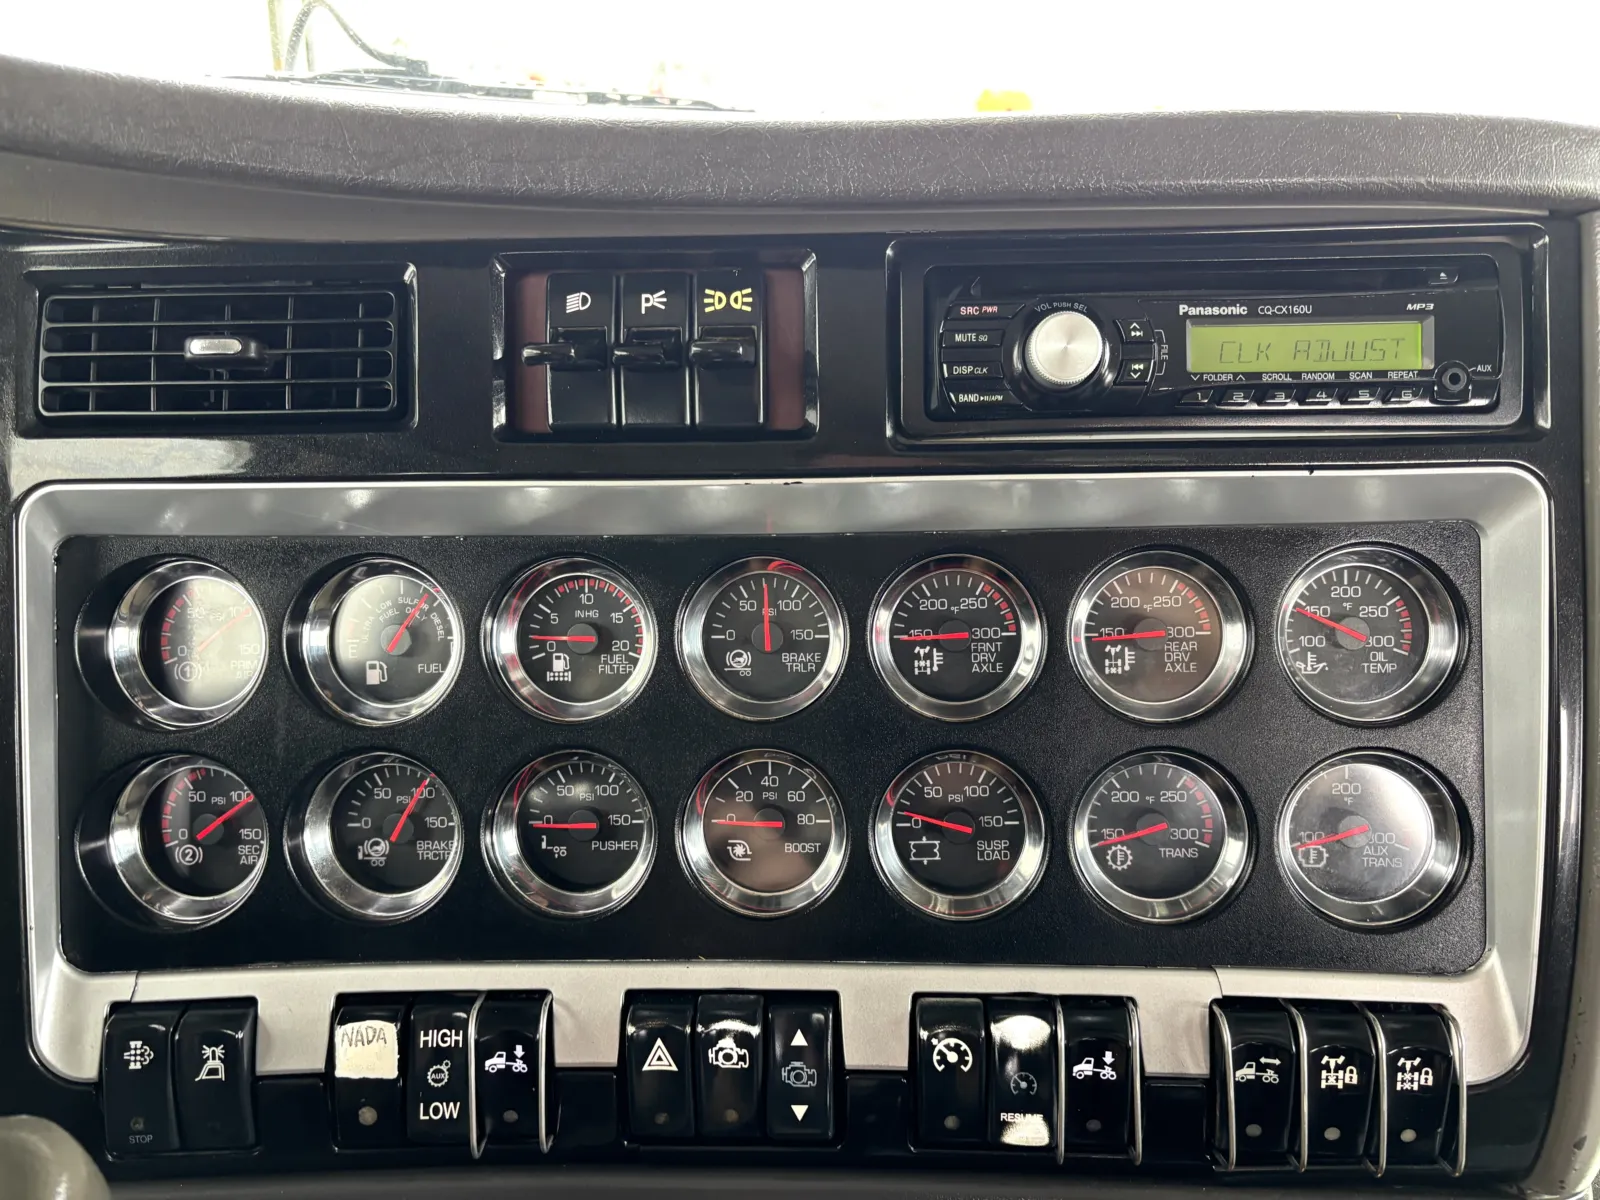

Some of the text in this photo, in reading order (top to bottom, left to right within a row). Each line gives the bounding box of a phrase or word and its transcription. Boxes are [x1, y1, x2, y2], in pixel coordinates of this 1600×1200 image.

[960, 306, 979, 315] SRC
[1034, 302, 1052, 313] VOL
[1073, 302, 1088, 313] SEL
[1179, 304, 1312, 316] Panasonic CQ-CX160U
[1406, 303, 1434, 311] MP3
[955, 333, 988, 342] MUTE SQ
[1219, 338, 1405, 364] CLK ADJUST
[952, 366, 988, 375] DISP CLK
[1477, 364, 1492, 372] AUX
[1203, 374, 1233, 382] FOLDER
[1262, 373, 1292, 382] SCROLL
[1301, 372, 1335, 381] RANDOM
[1349, 372, 1373, 380] SCAN
[1387, 371, 1418, 380] REPEAT
[958, 394, 979, 403] BAND
[1196, 392, 1202, 401] 1
[1232, 392, 1245, 401] 2
[1274, 392, 1286, 401] 3
[1316, 391, 1328, 400] 4
[1358, 390, 1370, 399] 5
[1401, 390, 1413, 399] 6
[1330, 586, 1362, 598] 200
[579, 593, 594, 605] 10
[776, 599, 802, 611] 100
[919, 599, 948, 611] 200
[960, 597, 988, 609] 250
[1110, 596, 1141, 609] 200
[1153, 595, 1182, 607] 250
[739, 600, 757, 611] 50
[1359, 605, 1389, 618] 250
[187, 607, 205, 619] 50
[378, 607, 400, 623] FUEL
[550, 612, 559, 624] 5
[609, 612, 624, 624] 15
[1304, 606, 1331, 618] 150
[362, 616, 375, 643] ULTRA
[375, 599, 393, 614] LOW
[430, 612, 445, 642] DIESEL
[726, 629, 736, 641] 0
[790, 629, 814, 641] 150
[908, 629, 933, 638] 150
[971, 627, 1001, 639] 300
[1099, 627, 1125, 638] 150
[1166, 626, 1195, 638] 300
[546, 640, 556, 652] 0
[611, 640, 630, 652] 20
[970, 642, 1003, 653] FRNT
[1164, 641, 1198, 652] REAR
[1298, 635, 1326, 648] 100
[1365, 635, 1395, 648] 300
[177, 645, 188, 657] 0
[239, 643, 260, 655] 150
[348, 644, 358, 659] E
[600, 653, 629, 664] FUEL
[781, 652, 822, 663] BRAKE
[971, 653, 997, 663] DRV
[1164, 652, 1191, 663] DRV
[1370, 651, 1389, 662] OIL
[230, 660, 258, 670] PRIM
[417, 663, 446, 674] FUEL
[598, 664, 634, 675] FILTER
[785, 662, 816, 673] TRLR
[971, 663, 1004, 673] AXLE
[1164, 662, 1198, 673] AXLE
[1361, 663, 1398, 674] TEMP
[760, 775, 779, 787] 40
[373, 787, 392, 800] 50
[410, 787, 436, 799] 100
[556, 785, 575, 797] 50
[594, 784, 619, 796] 100
[924, 786, 943, 798] 50
[963, 785, 990, 797] 100
[1331, 783, 1362, 795] 200
[188, 791, 206, 803] 50
[211, 796, 226, 805] PSI
[229, 791, 254, 802] 100
[396, 795, 411, 804] PSI
[579, 792, 595, 801] PSI
[735, 790, 754, 802] 20
[762, 791, 778, 800] PSI
[787, 790, 806, 802] 60
[948, 794, 964, 803] PSI
[1110, 790, 1140, 803] 200
[1160, 790, 1187, 803] 250
[361, 817, 372, 829] 0
[424, 816, 448, 829] 150
[607, 814, 631, 826] 150
[797, 813, 815, 825] 80
[911, 817, 922, 829] 0
[978, 815, 1003, 828] 150
[178, 828, 188, 840] 0
[238, 828, 262, 840] 150
[1100, 828, 1125, 840] 150
[1170, 828, 1199, 840] 300
[1298, 831, 1325, 843] 100
[237, 845, 260, 855] SEC
[416, 840, 455, 850] BRAKE
[591, 840, 639, 851] PUSHER
[784, 842, 821, 853] BOOST
[977, 840, 1010, 850] SUSP
[1363, 846, 1389, 856] AUX
[977, 850, 1010, 861] LOAD
[1158, 847, 1199, 858] TRANS
[239, 855, 259, 865] AIR
[1362, 857, 1403, 868] TRANS
[341, 1026, 387, 1048] NADA
[419, 1029, 463, 1049] HIGH
[430, 1071, 446, 1080] AUX
[419, 1101, 461, 1120] LOW
[128, 1134, 153, 1144] STOP
